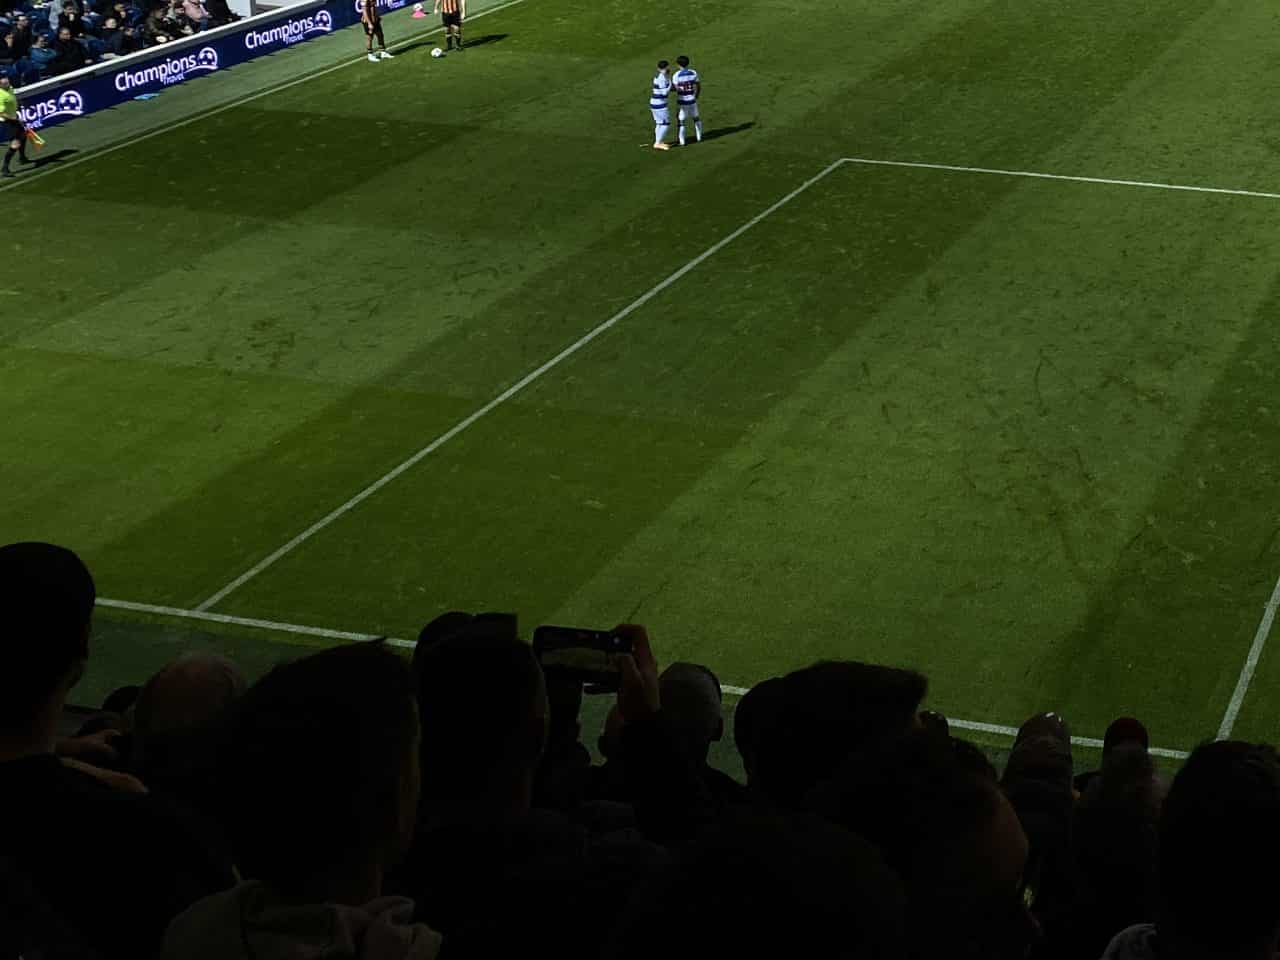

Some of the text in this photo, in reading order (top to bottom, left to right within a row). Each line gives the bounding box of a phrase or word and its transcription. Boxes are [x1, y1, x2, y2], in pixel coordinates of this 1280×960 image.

[244, 16, 314, 49] Champions
[115, 52, 197, 91] Champions
[163, 70, 185, 86] Travel
